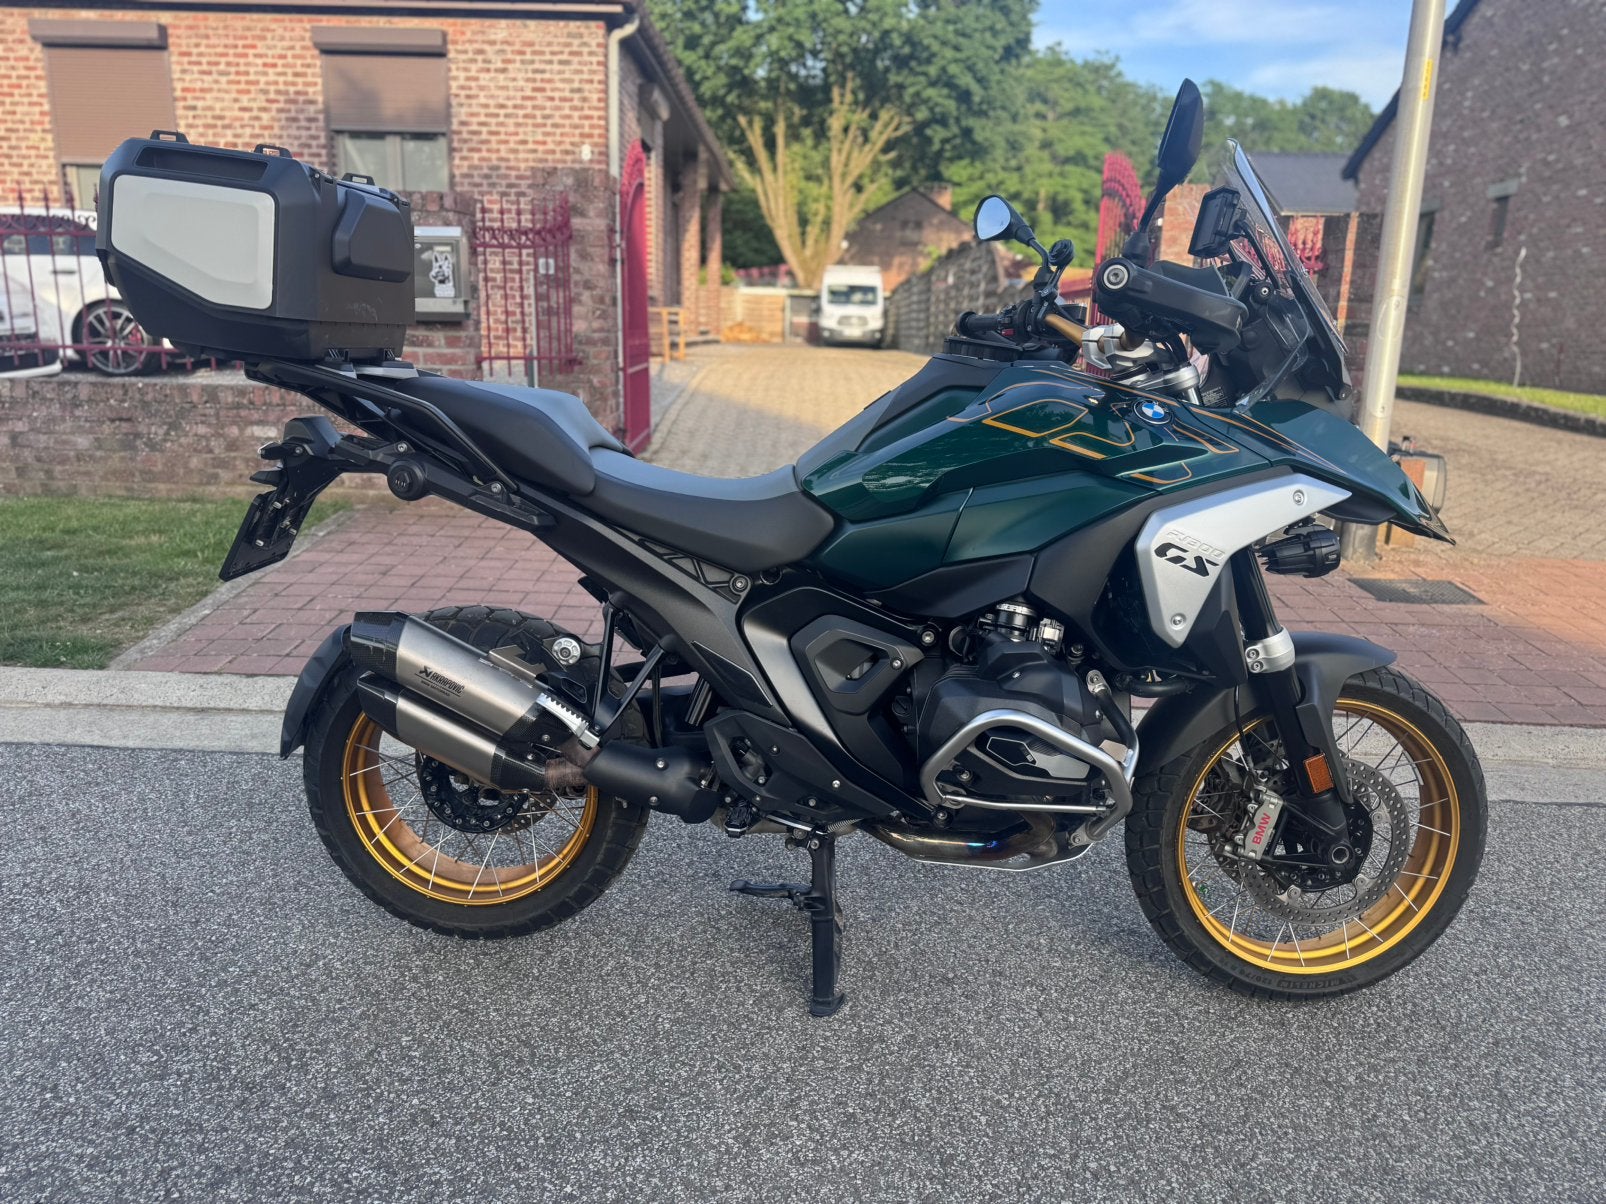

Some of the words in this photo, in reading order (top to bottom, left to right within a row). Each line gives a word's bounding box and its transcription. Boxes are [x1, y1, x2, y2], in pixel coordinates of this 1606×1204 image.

[1154, 542, 1220, 577] GS
[1252, 812, 1271, 845] BMW
[1280, 977, 1341, 990] MICHELIN
